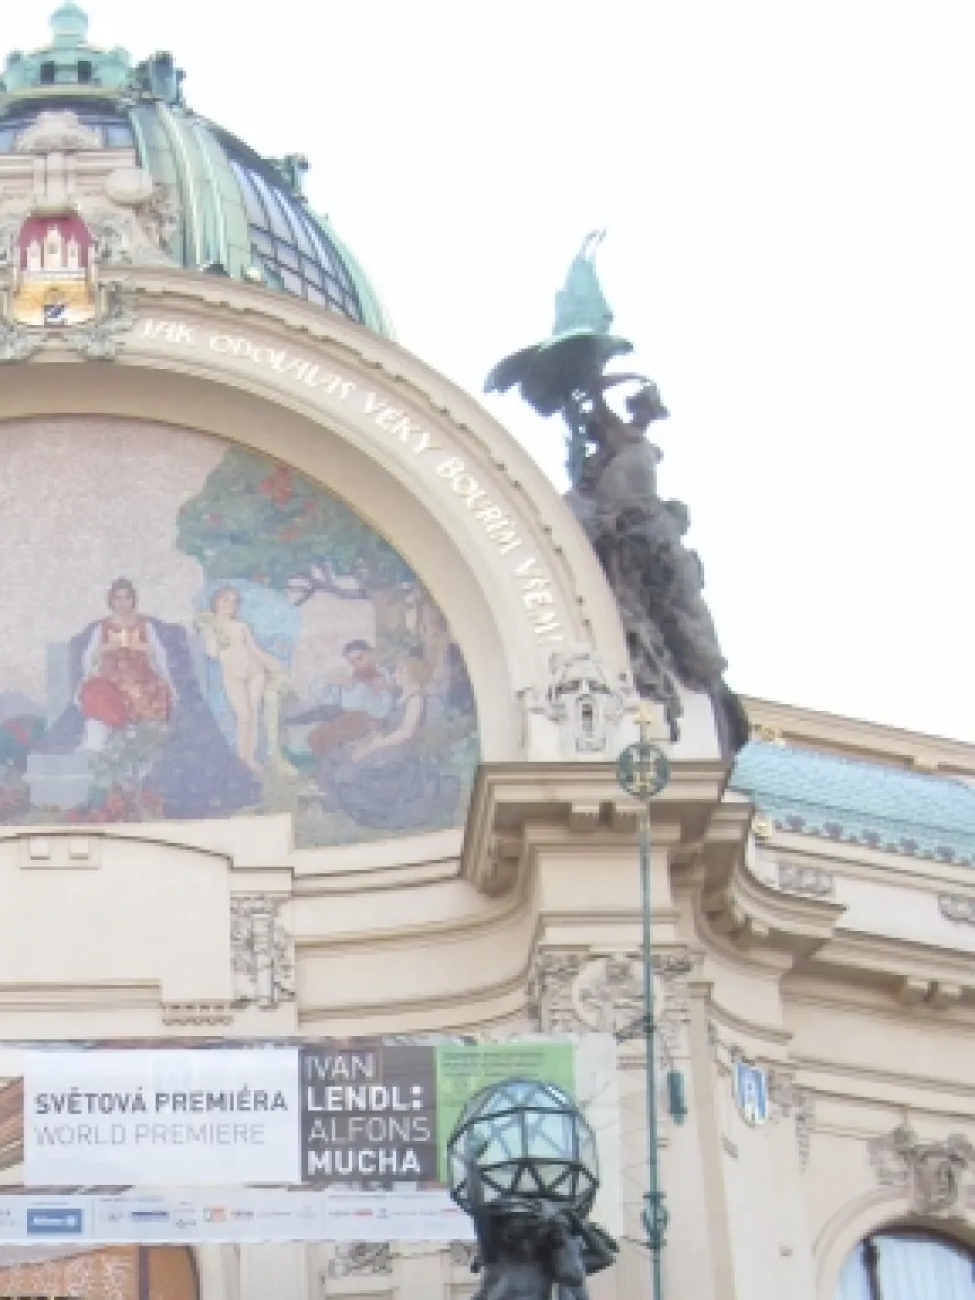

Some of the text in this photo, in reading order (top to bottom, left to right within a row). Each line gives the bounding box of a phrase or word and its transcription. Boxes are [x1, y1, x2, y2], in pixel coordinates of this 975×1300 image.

[305, 1053, 374, 1080] IVAN
[34, 1083, 289, 1115] SVĚTOVÁ PREMIÉRA
[307, 1085, 423, 1112] LENDL:
[34, 1123, 266, 1146] WORLD PREMIERE
[307, 1116, 431, 1143] ALFONS
[307, 1148, 421, 1176] MUCHA
